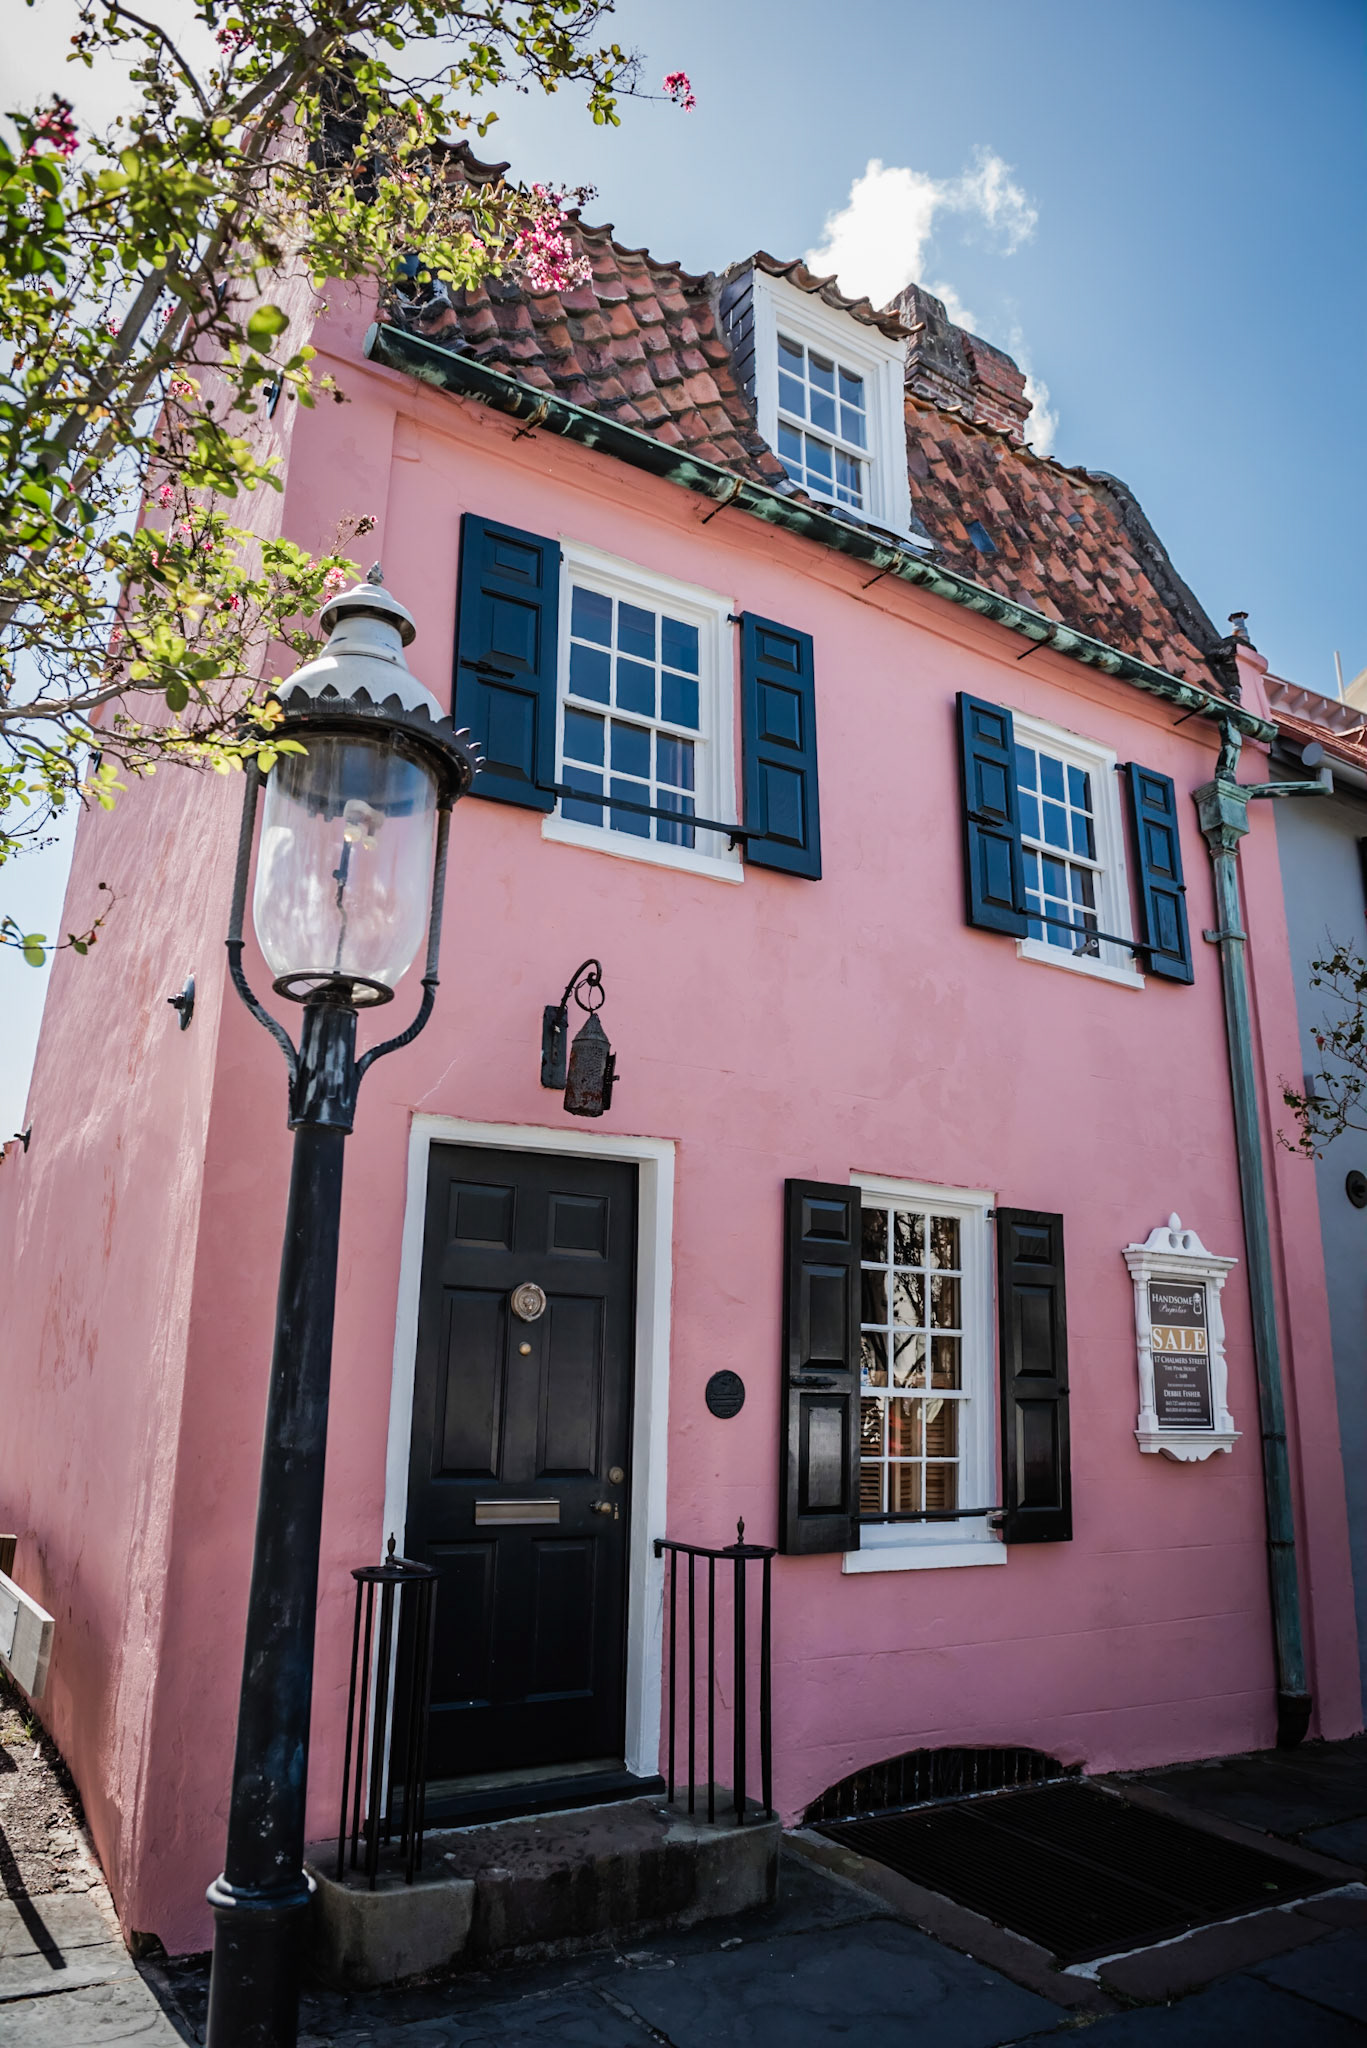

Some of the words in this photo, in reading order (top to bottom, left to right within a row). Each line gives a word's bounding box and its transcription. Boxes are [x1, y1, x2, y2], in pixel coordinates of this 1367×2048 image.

[1151, 1293, 1193, 1305] HANDSOME
[1153, 1328, 1205, 1351] SALE
[1154, 1355, 1160, 1363] 17
[1161, 1356, 1188, 1365] CHALMERS
[1189, 1357, 1206, 1365] STREET
[1183, 1390, 1201, 1398] FISHER
